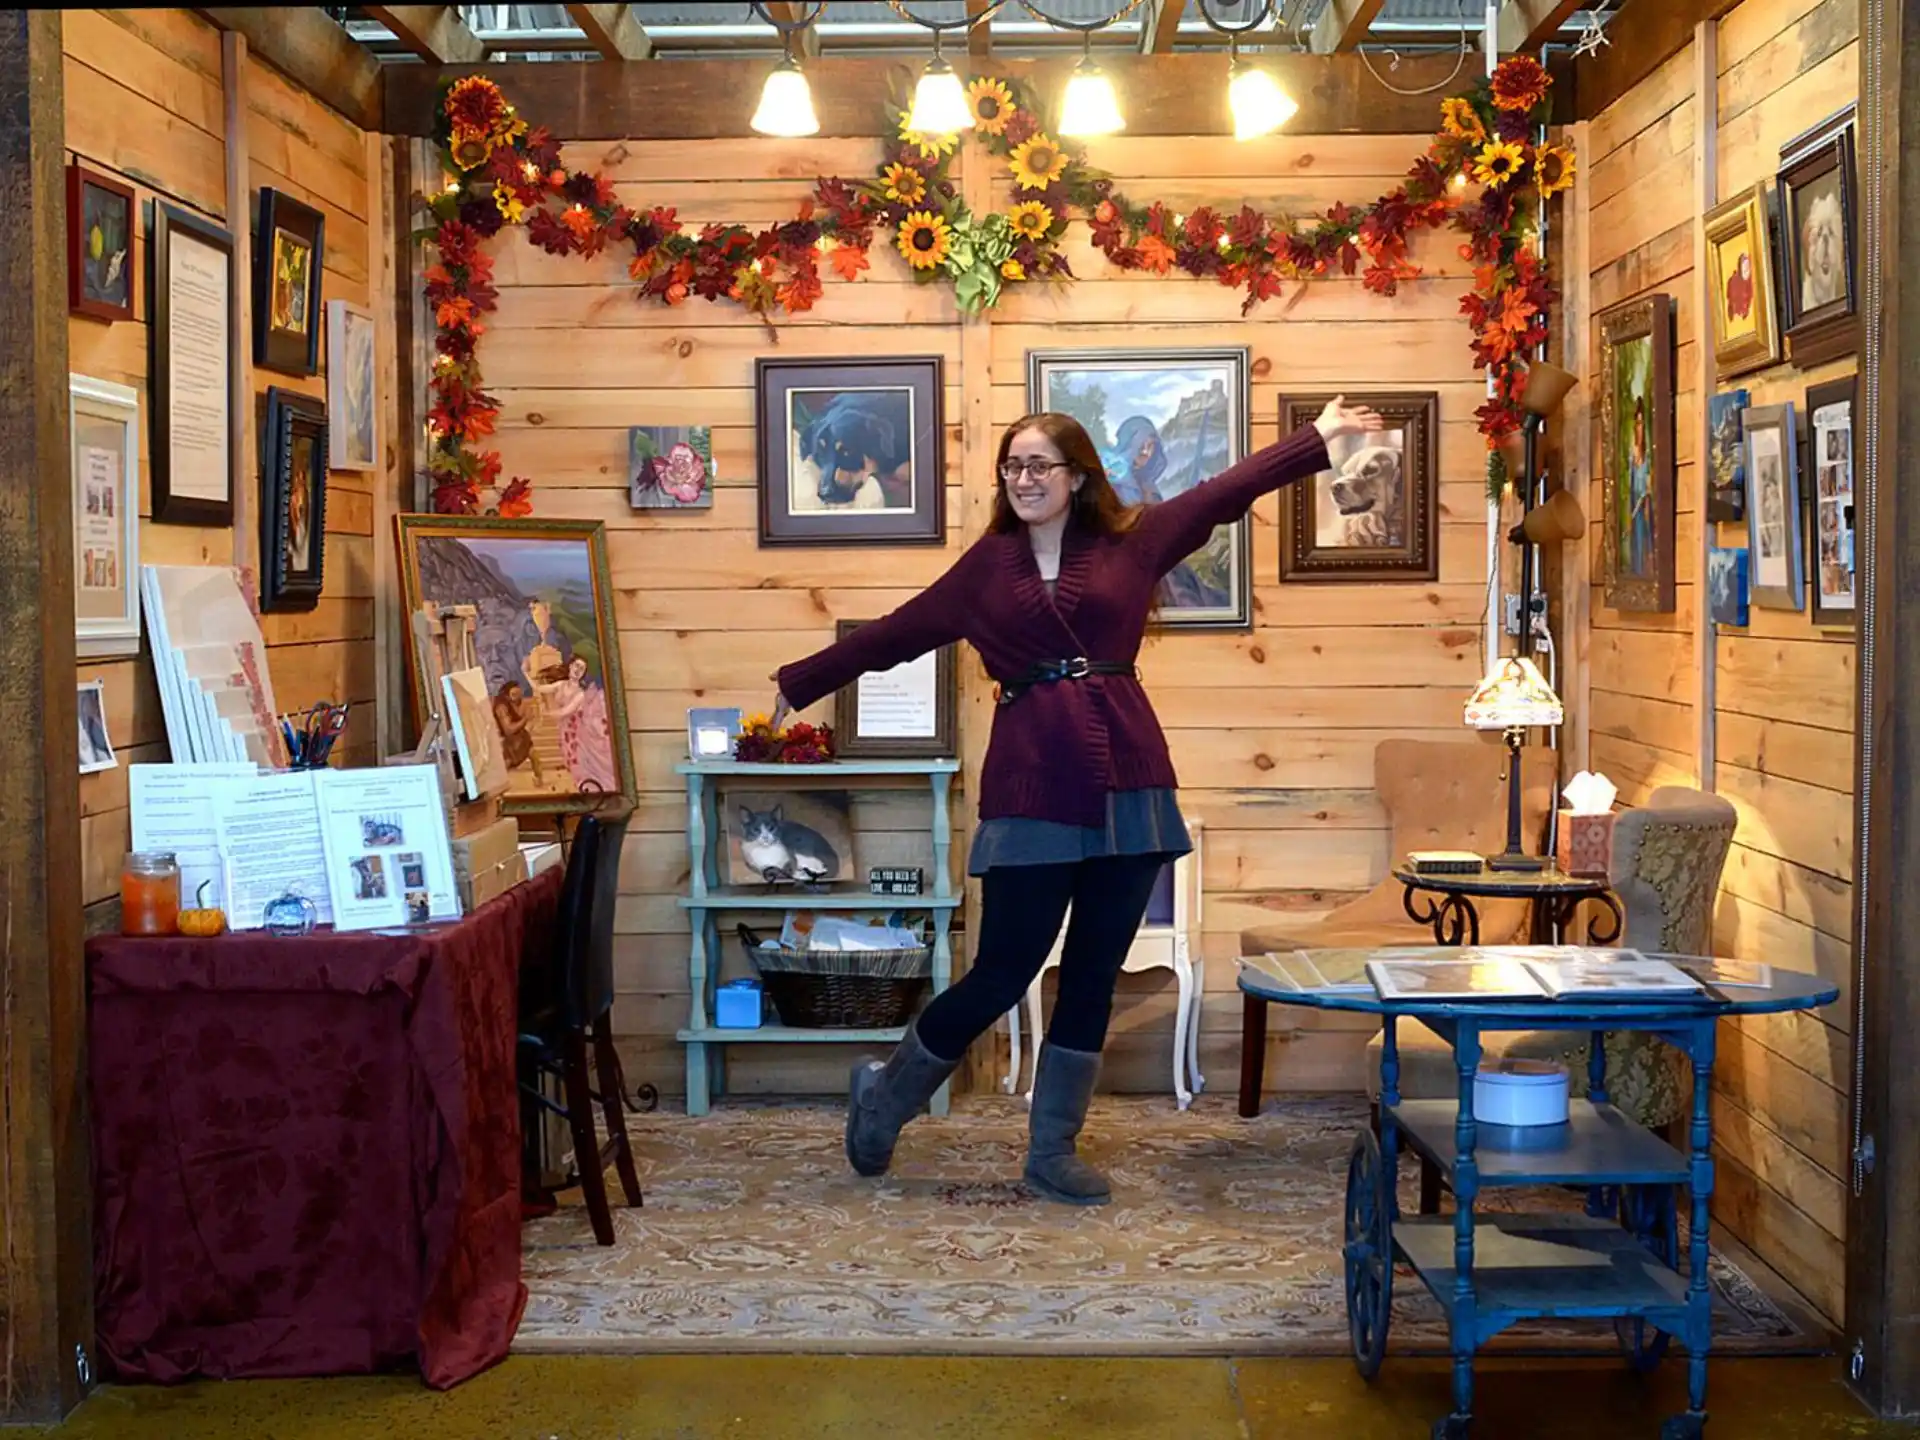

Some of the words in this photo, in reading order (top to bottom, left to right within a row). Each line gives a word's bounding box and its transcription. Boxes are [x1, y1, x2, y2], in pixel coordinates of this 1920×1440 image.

[871, 871, 881, 881] ALL
[882, 871, 893, 881] YOU
[907, 883, 917, 893] CAT
